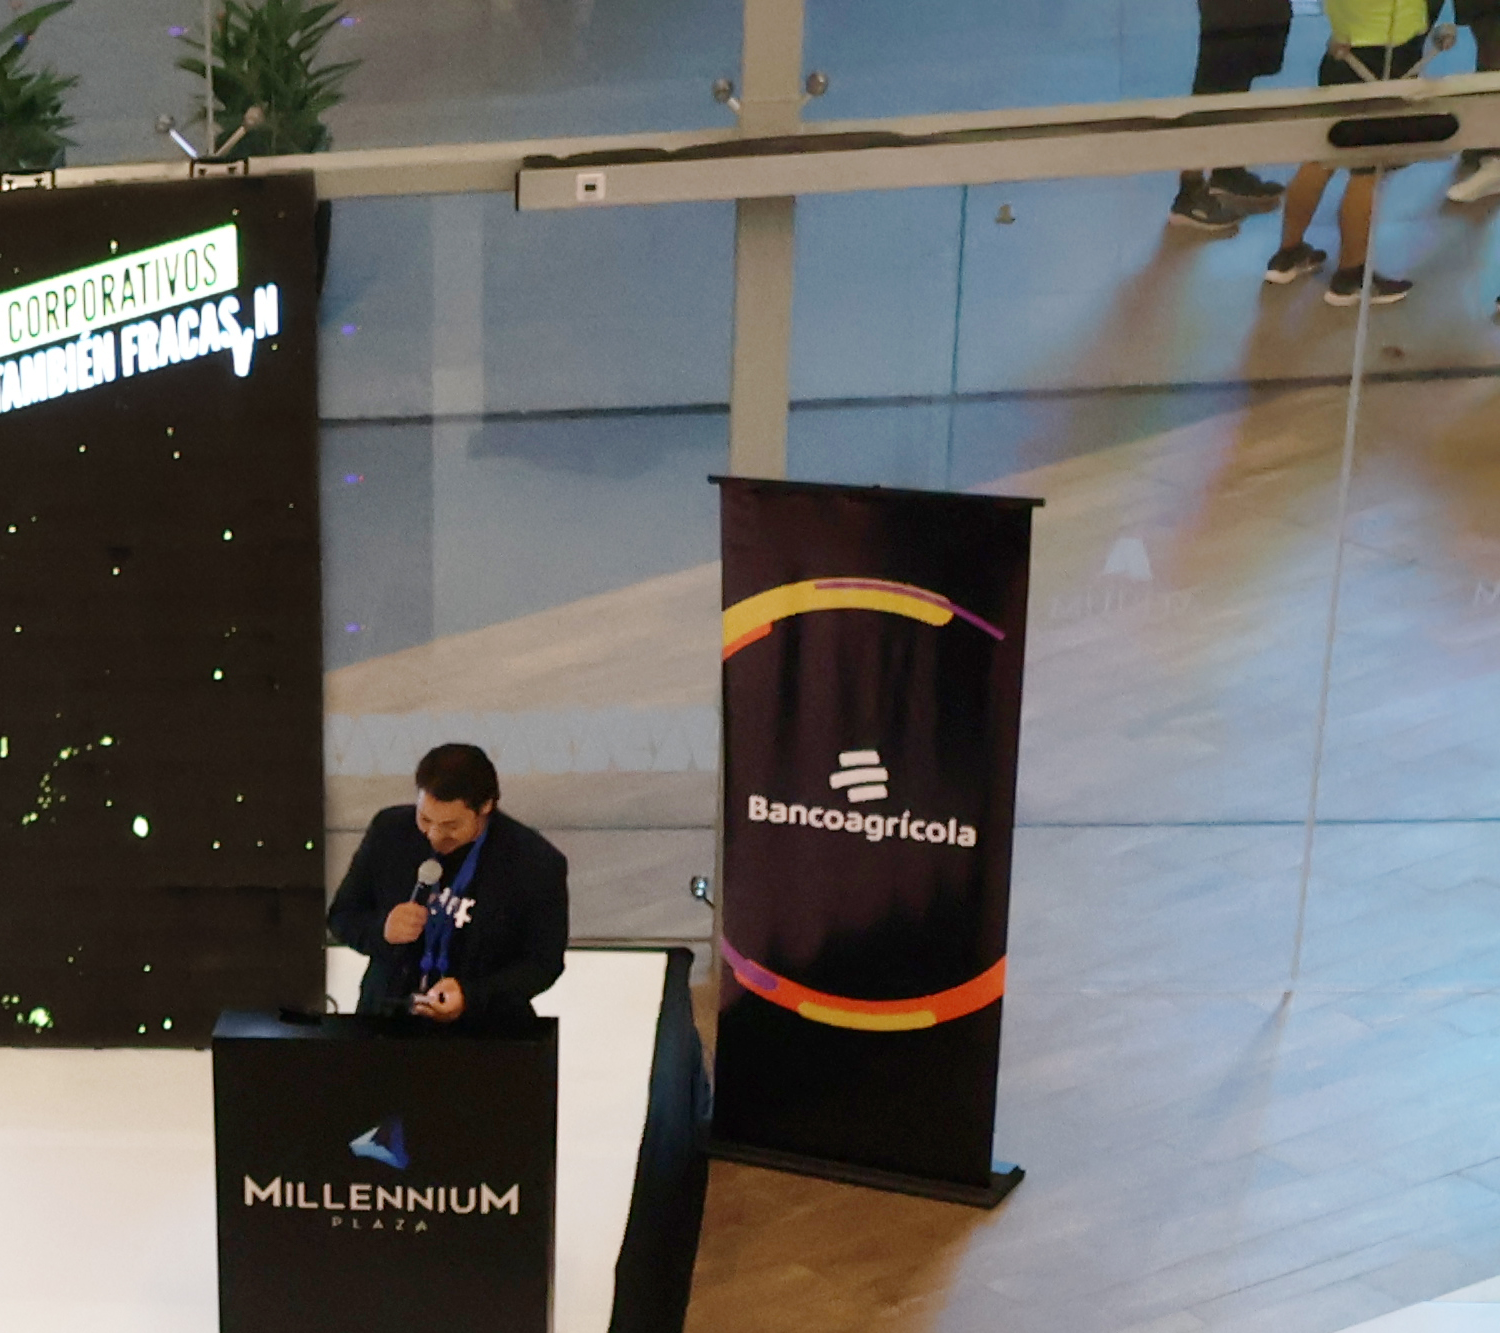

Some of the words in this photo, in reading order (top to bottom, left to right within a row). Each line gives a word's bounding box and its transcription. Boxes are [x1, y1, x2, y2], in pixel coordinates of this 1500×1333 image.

[8, 243, 218, 343] CORPORATIVOS
[748, 794, 977, 848] Bancoagrícola
[244, 1173, 520, 1216] MILLENNIUM
[330, 1216, 429, 1233] PLAZA
